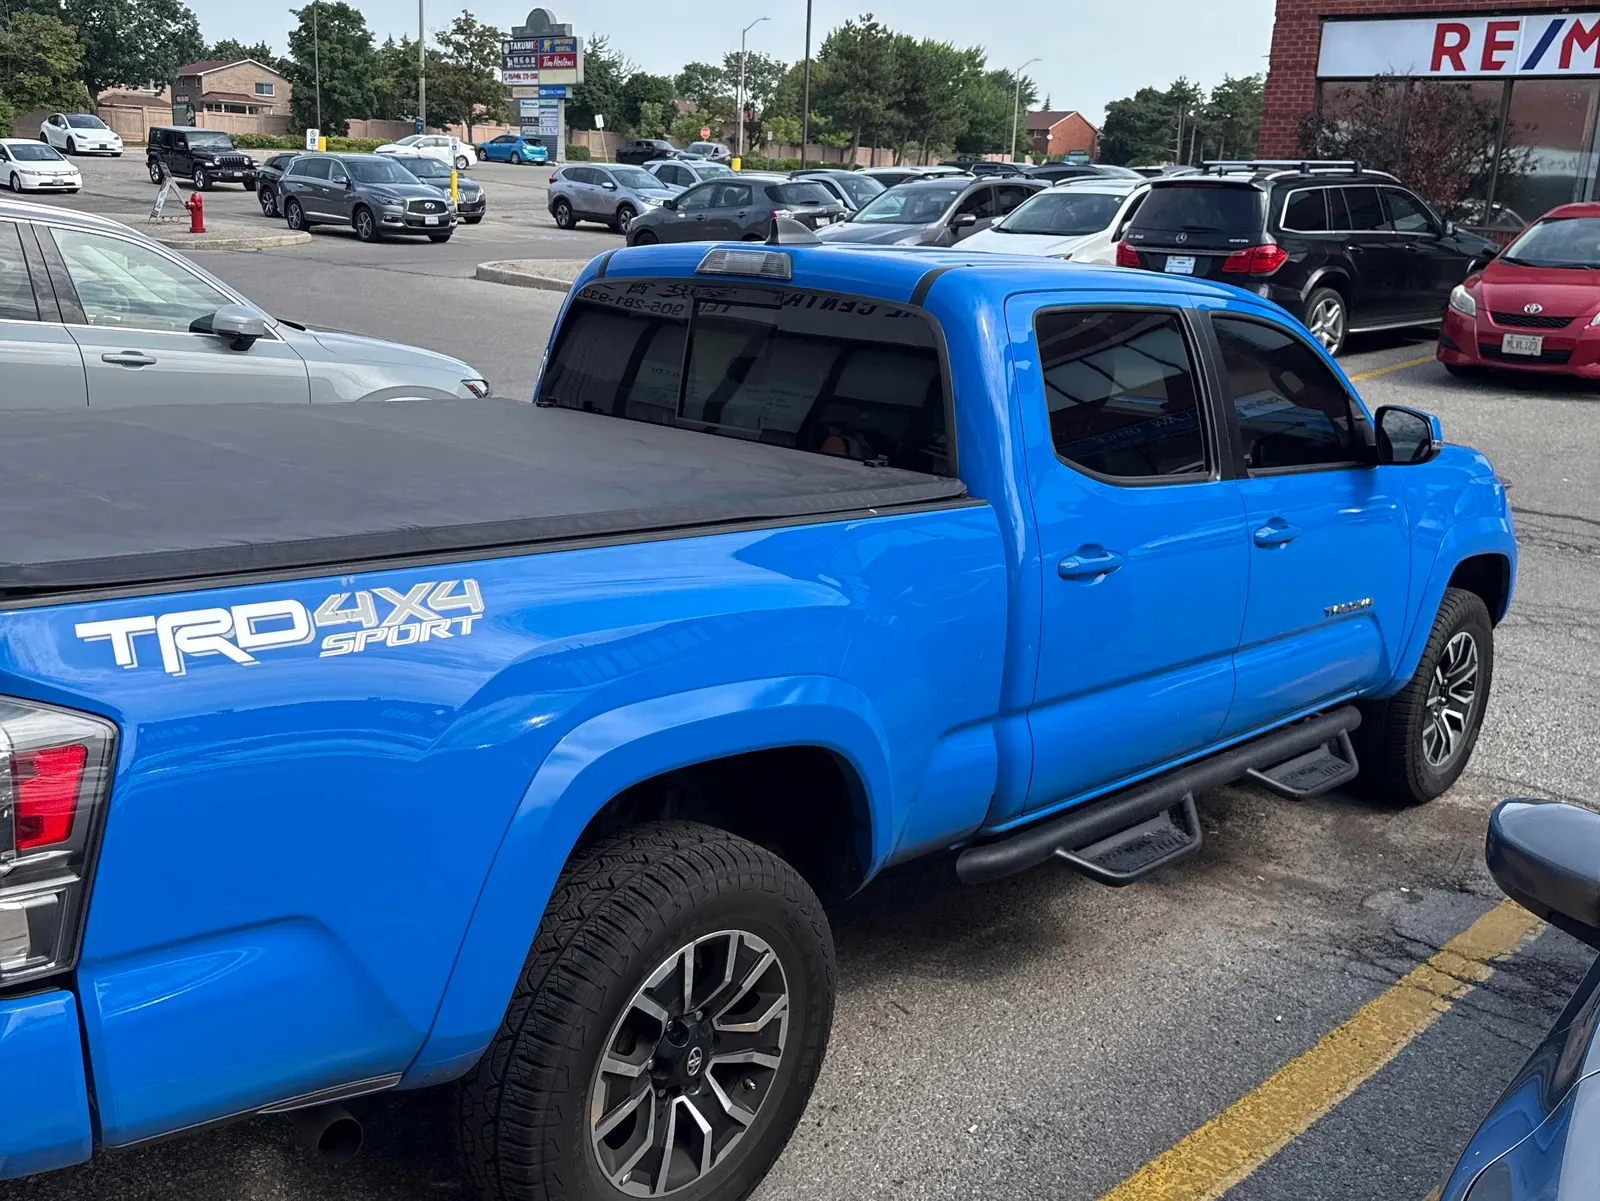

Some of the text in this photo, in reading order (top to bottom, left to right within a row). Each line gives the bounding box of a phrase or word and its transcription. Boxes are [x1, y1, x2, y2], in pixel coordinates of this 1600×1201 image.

[510, 41, 534, 51] TAKUMI
[75, 599, 316, 677] TRD
[318, 613, 483, 657] SPORT
